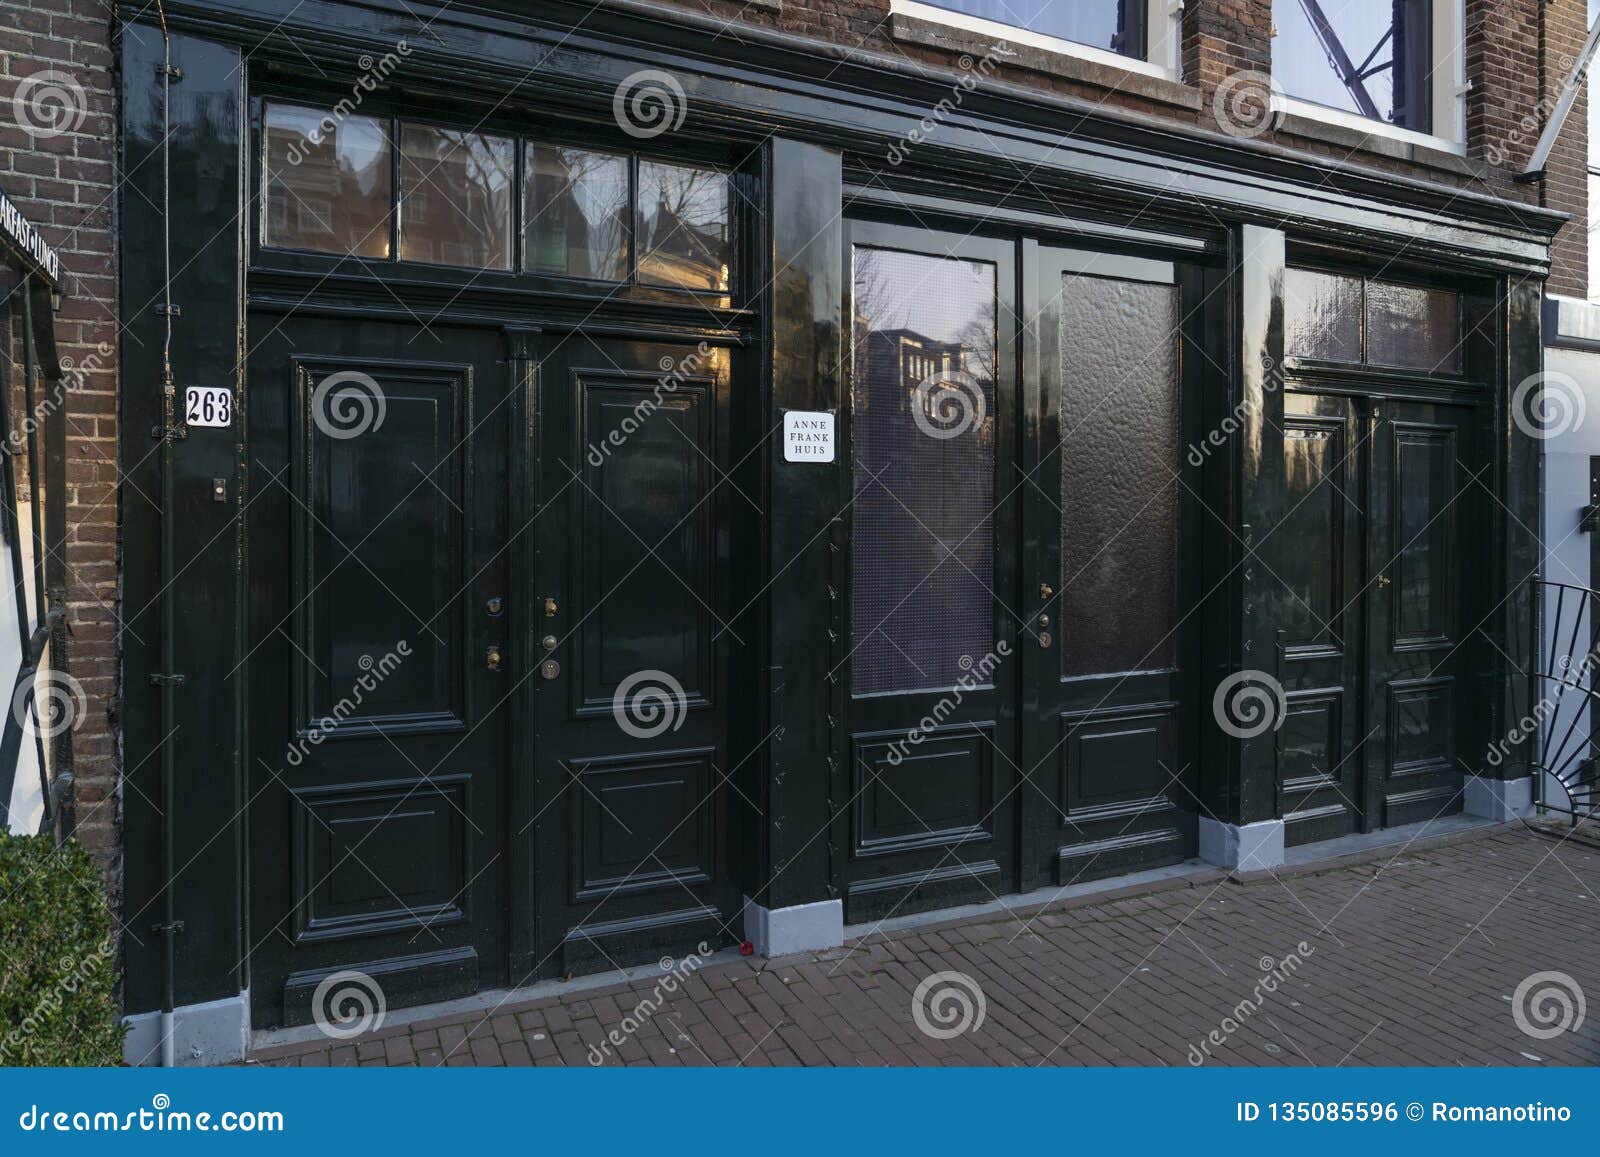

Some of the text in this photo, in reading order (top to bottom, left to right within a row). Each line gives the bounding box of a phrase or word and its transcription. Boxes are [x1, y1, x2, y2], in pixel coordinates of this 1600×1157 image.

[0, 194, 59, 281] AKFAST LUNCH
[188, 390, 229, 422] 263
[793, 420, 826, 430] ANNE
[790, 432, 829, 442] FRANK
[794, 445, 825, 455] HUIS
